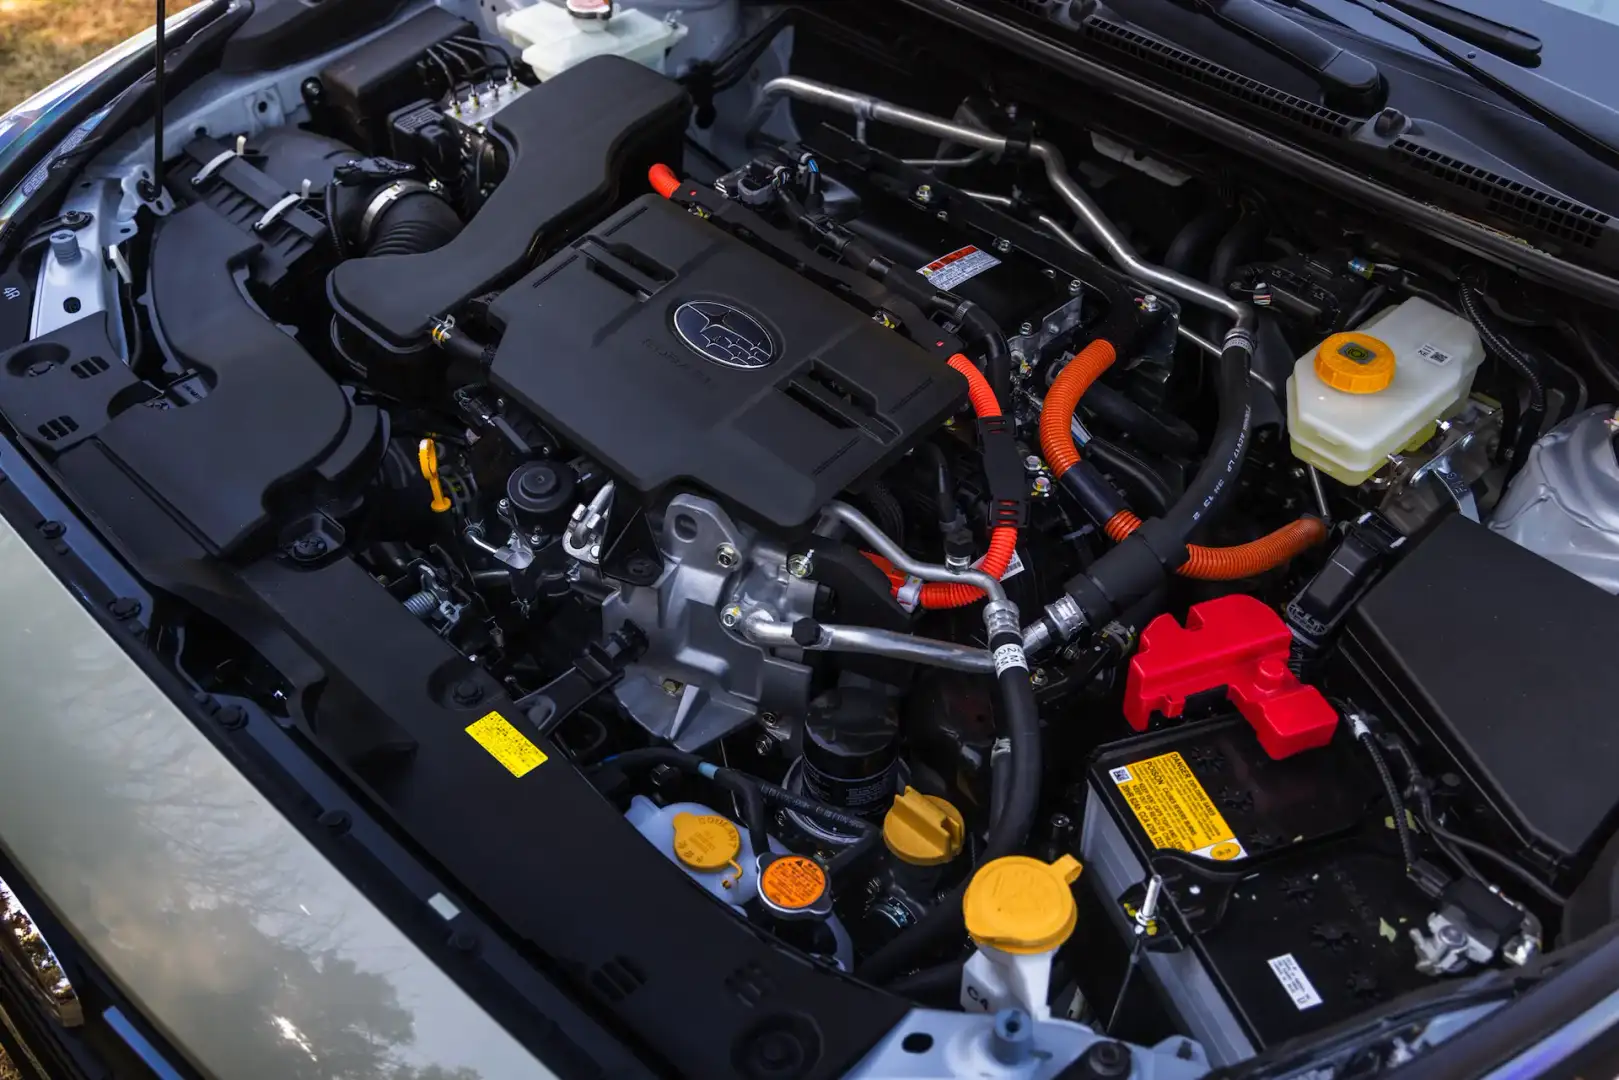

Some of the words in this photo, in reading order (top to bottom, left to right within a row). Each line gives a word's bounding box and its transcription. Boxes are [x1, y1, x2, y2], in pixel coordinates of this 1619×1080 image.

[1169, 753, 1192, 779] DANGER
[1131, 784, 1143, 796] KEEP
[1138, 795, 1148, 805] OUT
[1144, 760, 1164, 784] POISON
[1161, 787, 1176, 804] CAUSES
[1137, 782, 1149, 794] KEEP
[1145, 793, 1156, 805] VENT
[1151, 804, 1164, 816] CAPS
[1167, 829, 1178, 838] AND
[1137, 810, 1151, 823] CCA
